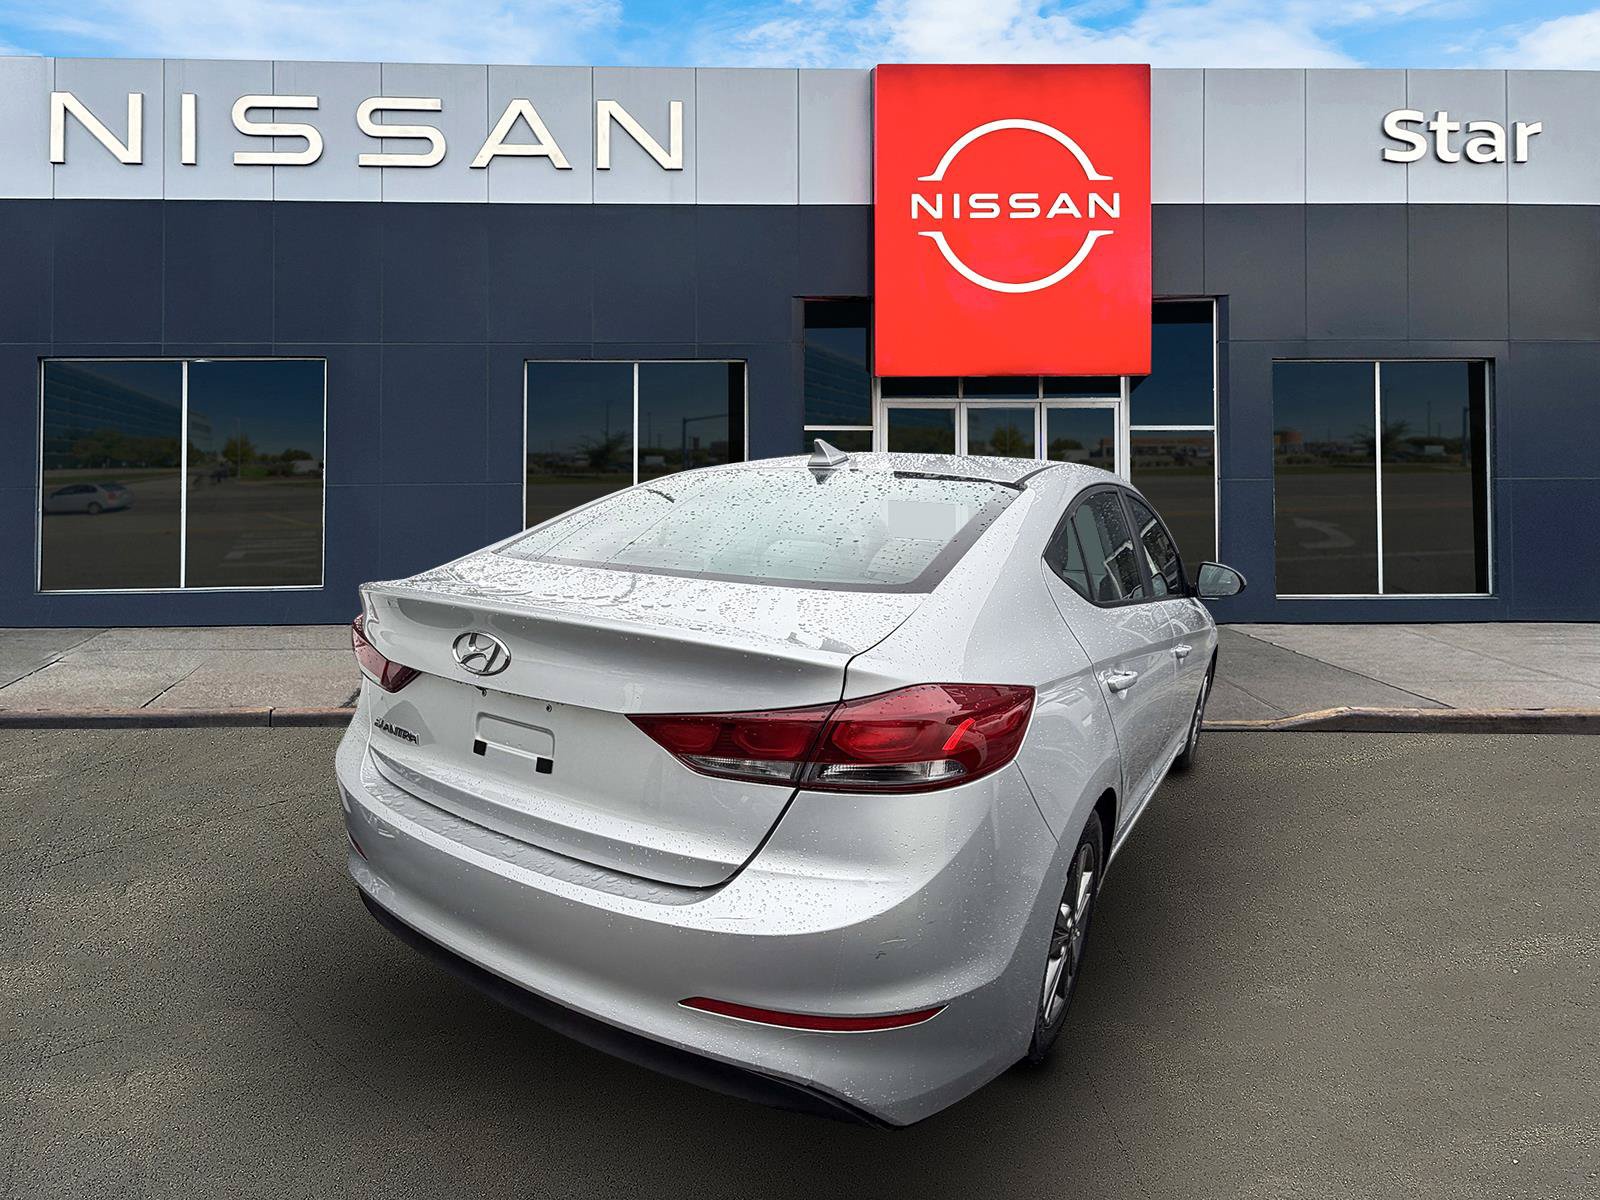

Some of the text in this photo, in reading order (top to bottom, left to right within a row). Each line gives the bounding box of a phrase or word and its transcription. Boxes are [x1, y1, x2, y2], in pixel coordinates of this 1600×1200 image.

[50, 91, 683, 171] NISSAN
[1381, 108, 1543, 165] Star
[911, 191, 1120, 221] NISSAN
